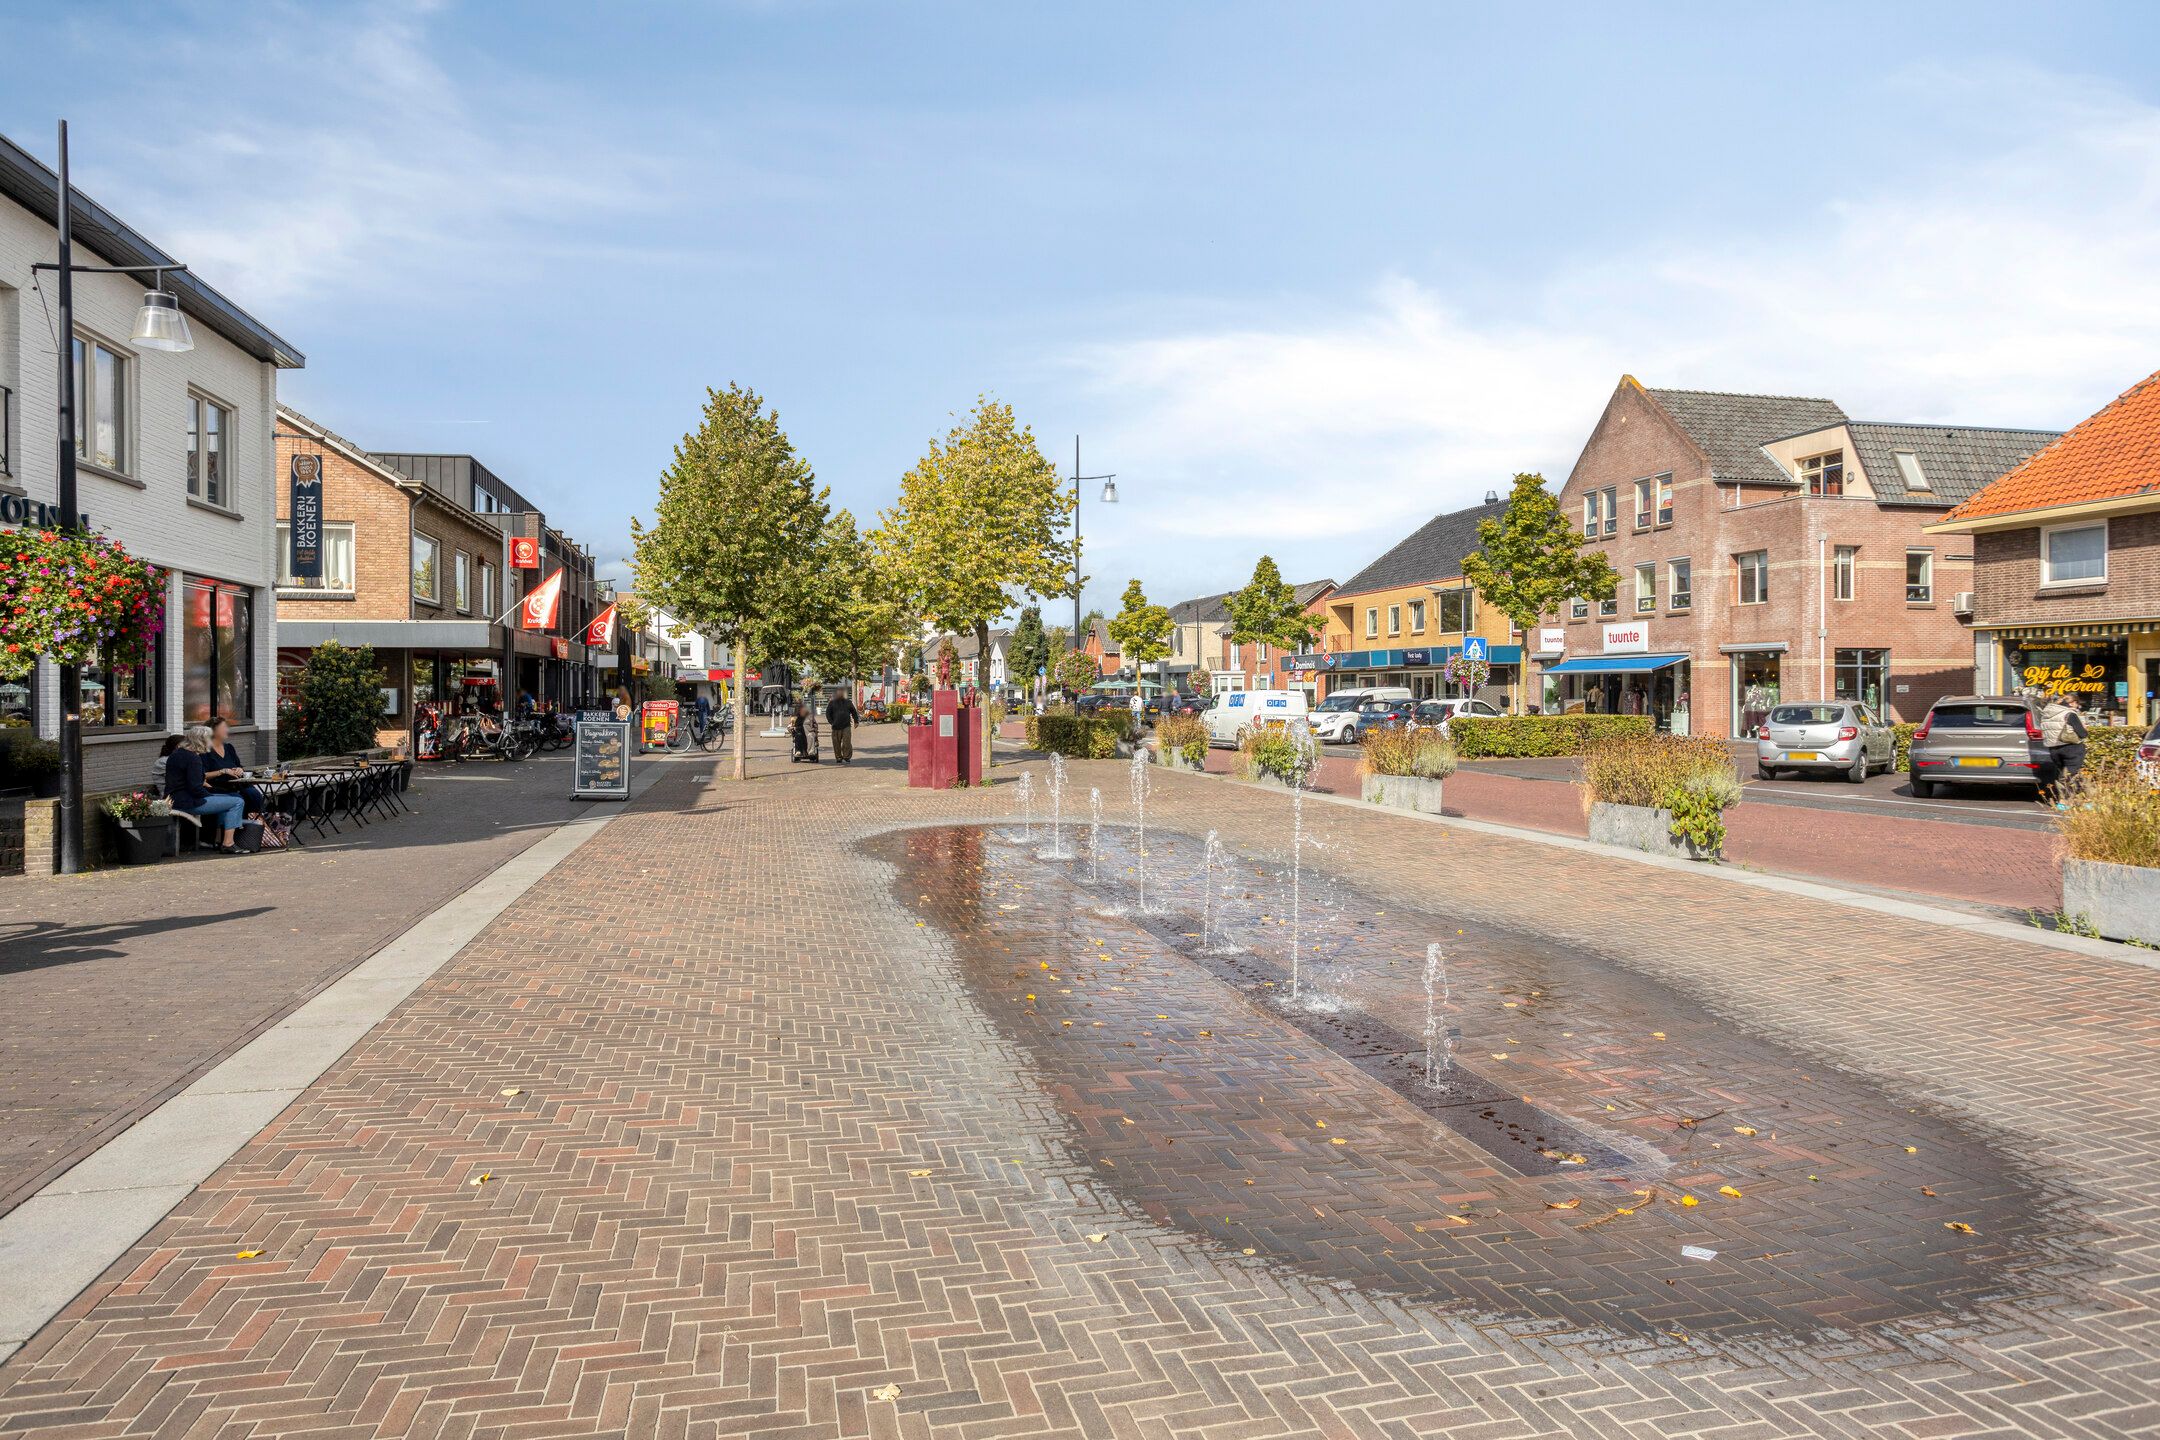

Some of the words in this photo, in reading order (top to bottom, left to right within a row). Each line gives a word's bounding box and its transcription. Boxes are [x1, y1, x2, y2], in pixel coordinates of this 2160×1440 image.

[297, 496, 305, 547] BAKKERIJ
[306, 496, 316, 547] KOENEN
[1608, 631, 1640, 643] tuunte
[1295, 661, 1316, 670] Domino's
[2024, 666, 2050, 686] Bij
[2052, 665, 2071, 678] de
[2044, 678, 2104, 695] Heeren
[1229, 694, 1245, 707] OFN
